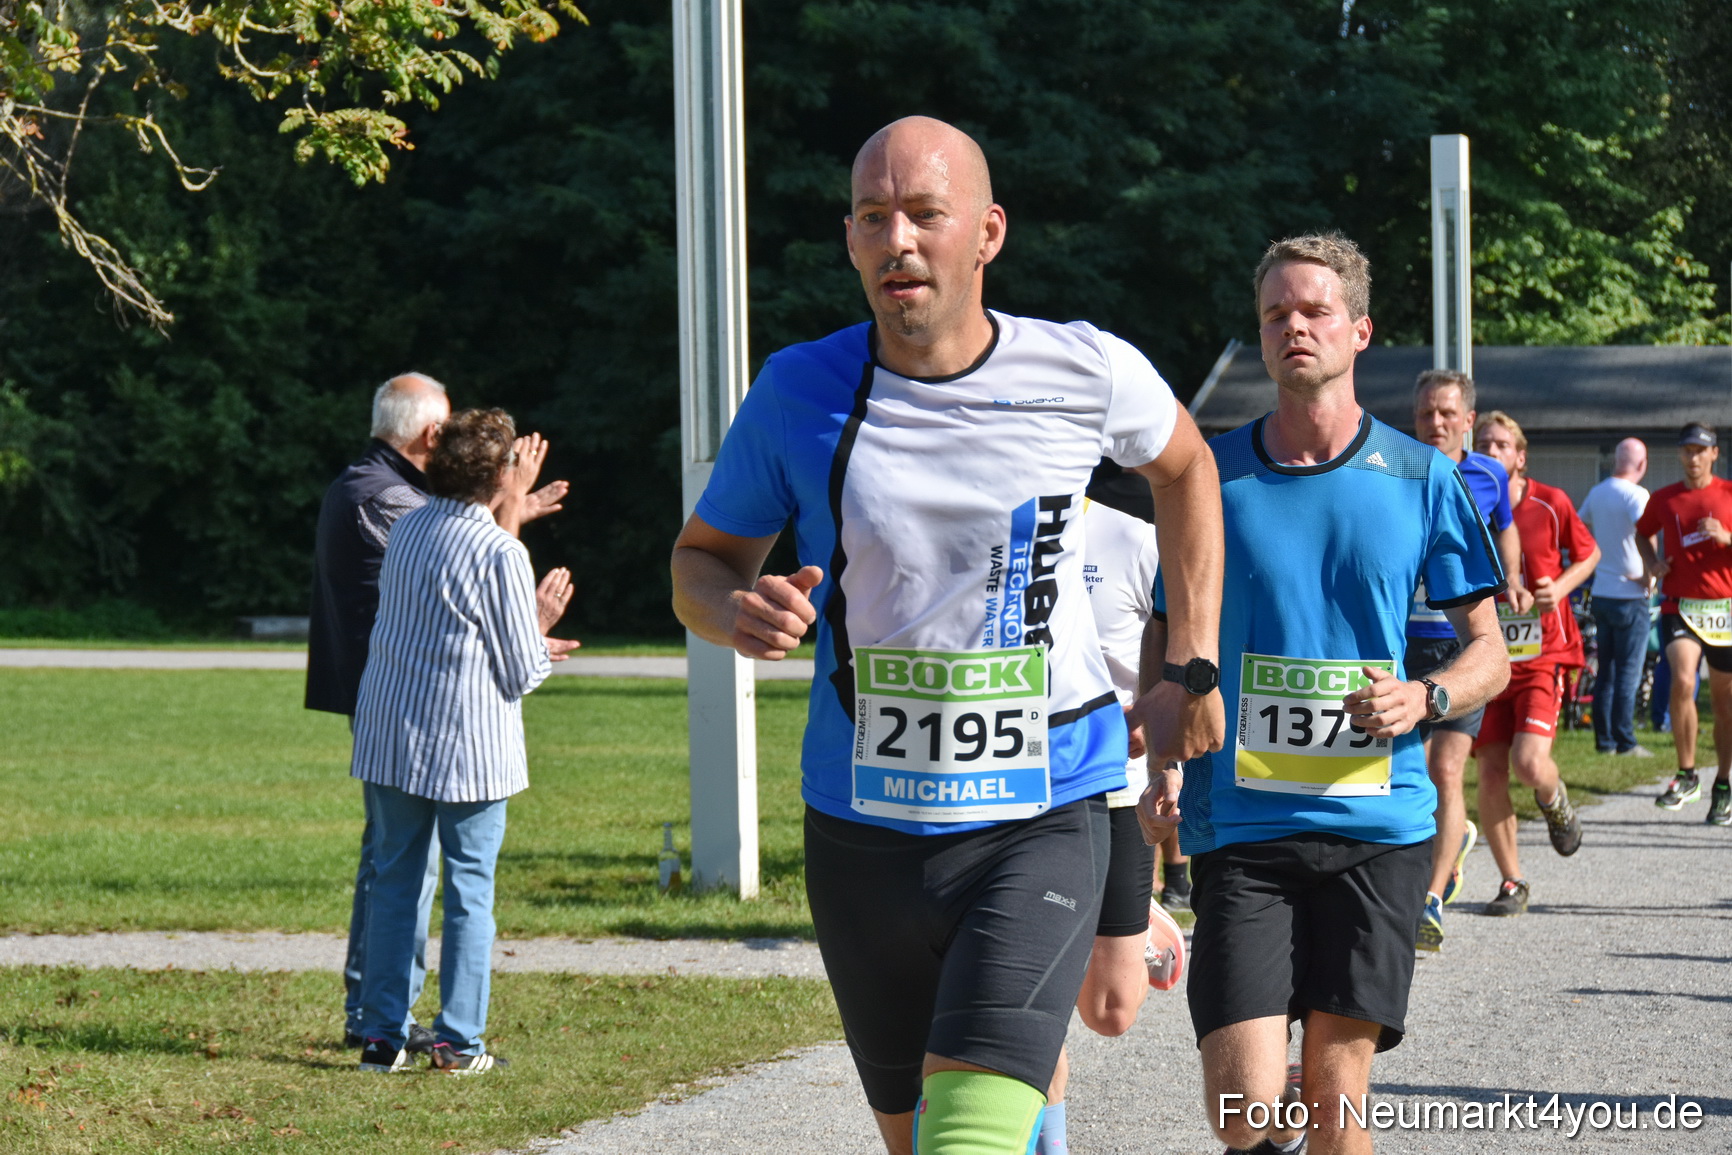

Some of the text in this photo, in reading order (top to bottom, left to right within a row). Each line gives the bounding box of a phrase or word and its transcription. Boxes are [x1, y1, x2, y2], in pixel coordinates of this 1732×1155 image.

[981, 545, 1003, 648] WASTE WATER
[1500, 623, 1532, 642] 07
[869, 653, 1032, 696] BOCK
[1031, 711, 1039, 720] D
[876, 706, 1024, 762] 2195
[884, 776, 1015, 801] MICHAEL
